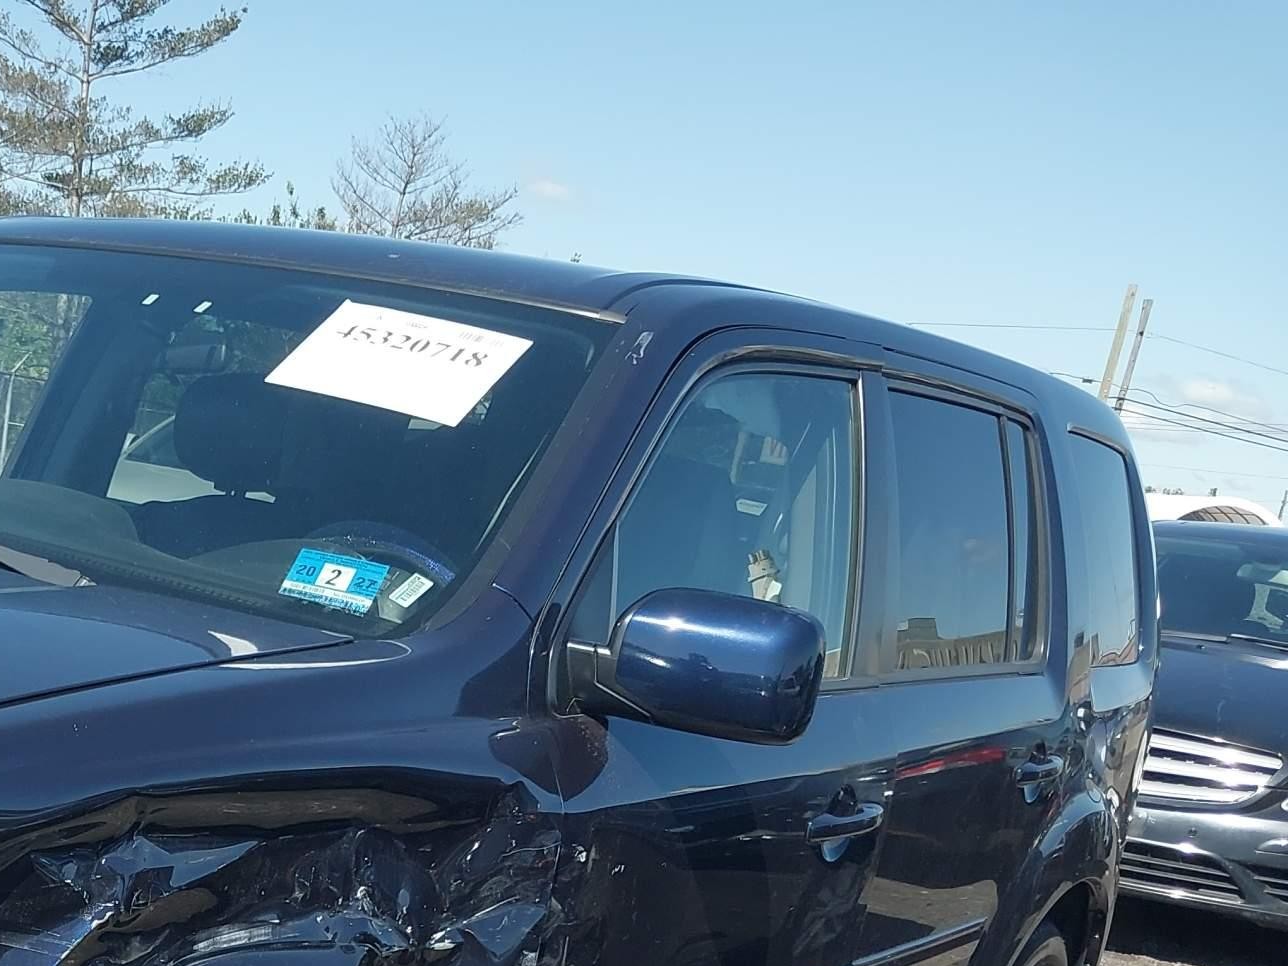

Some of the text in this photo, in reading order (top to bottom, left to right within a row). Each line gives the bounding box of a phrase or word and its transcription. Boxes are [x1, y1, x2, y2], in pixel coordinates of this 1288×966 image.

[336, 325, 488, 367] 45320718
[295, 564, 317, 577] 20
[324, 568, 343, 587] 2
[353, 576, 379, 591] 27
